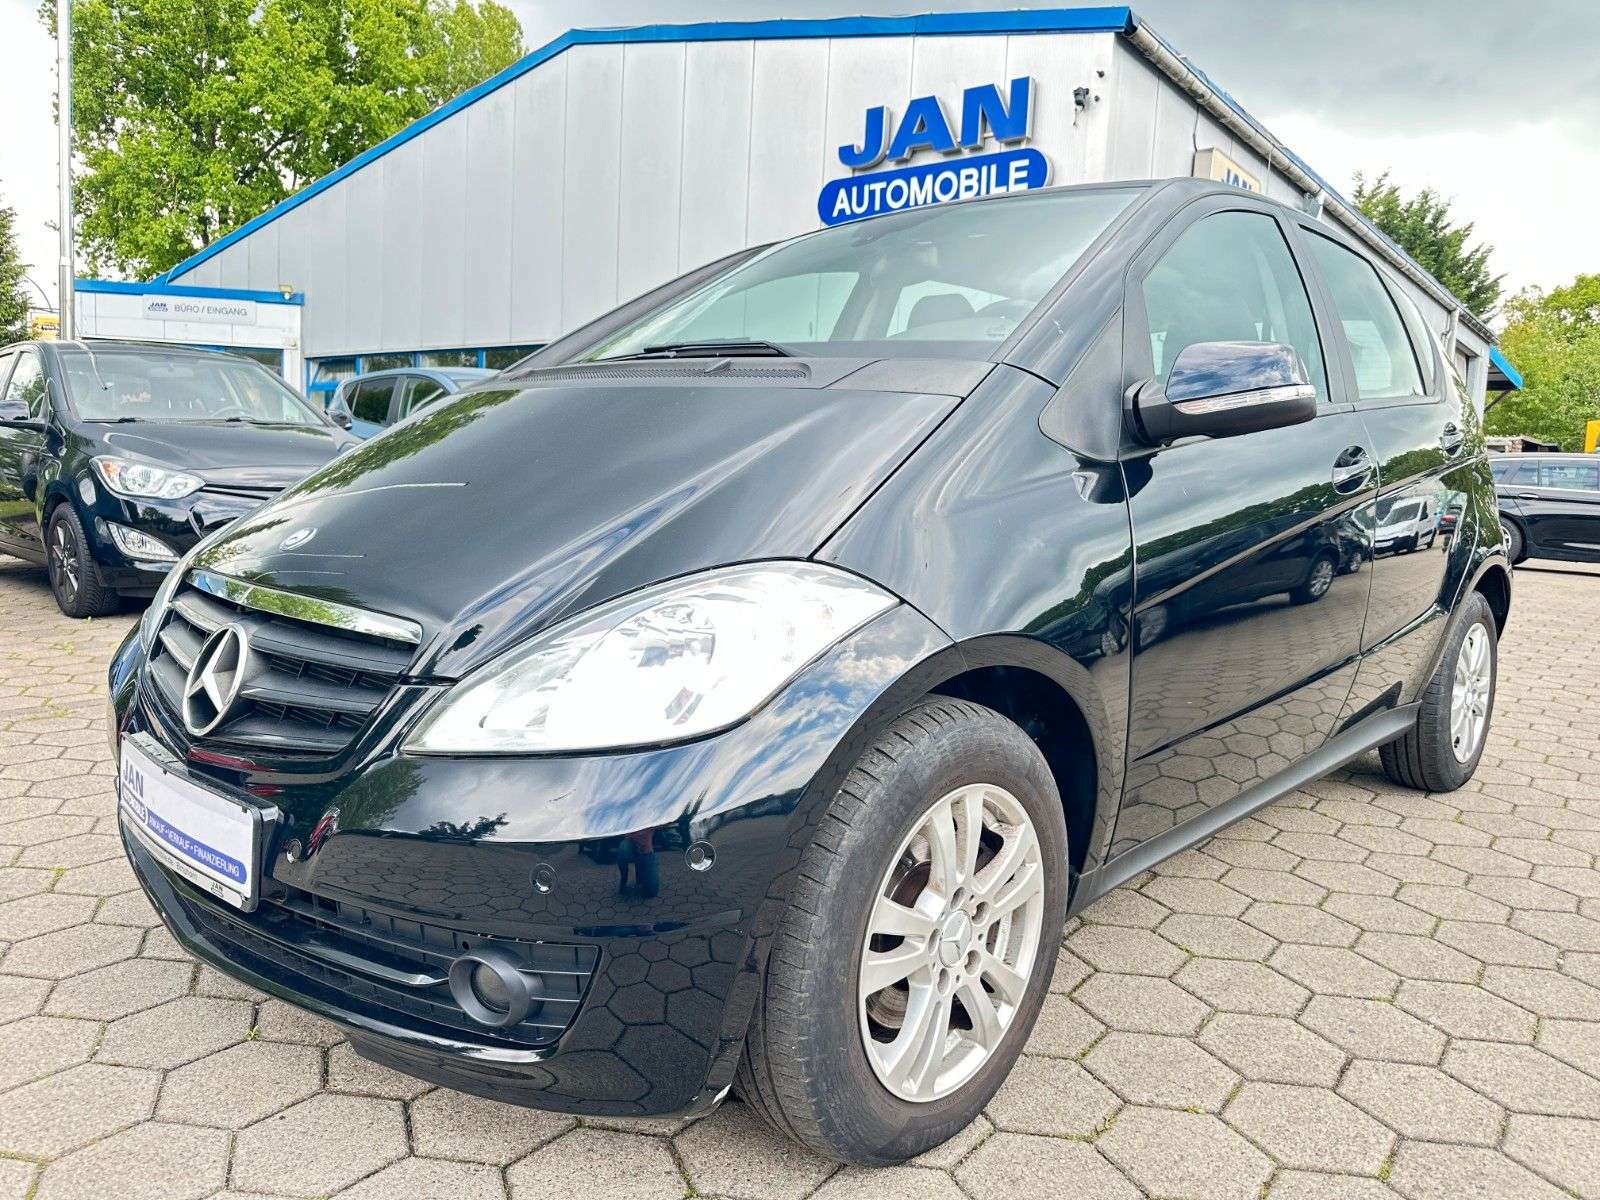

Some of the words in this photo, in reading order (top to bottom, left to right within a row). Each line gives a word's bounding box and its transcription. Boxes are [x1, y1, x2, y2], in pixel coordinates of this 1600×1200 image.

[838, 76, 1033, 168] JAN
[832, 159, 1030, 218] AUTOMOBILE
[175, 303, 200, 314] BÜRO
[207, 305, 248, 316] EINGANG
[122, 759, 144, 798] JAN
[193, 844, 240, 878] FINANZIERUNG
